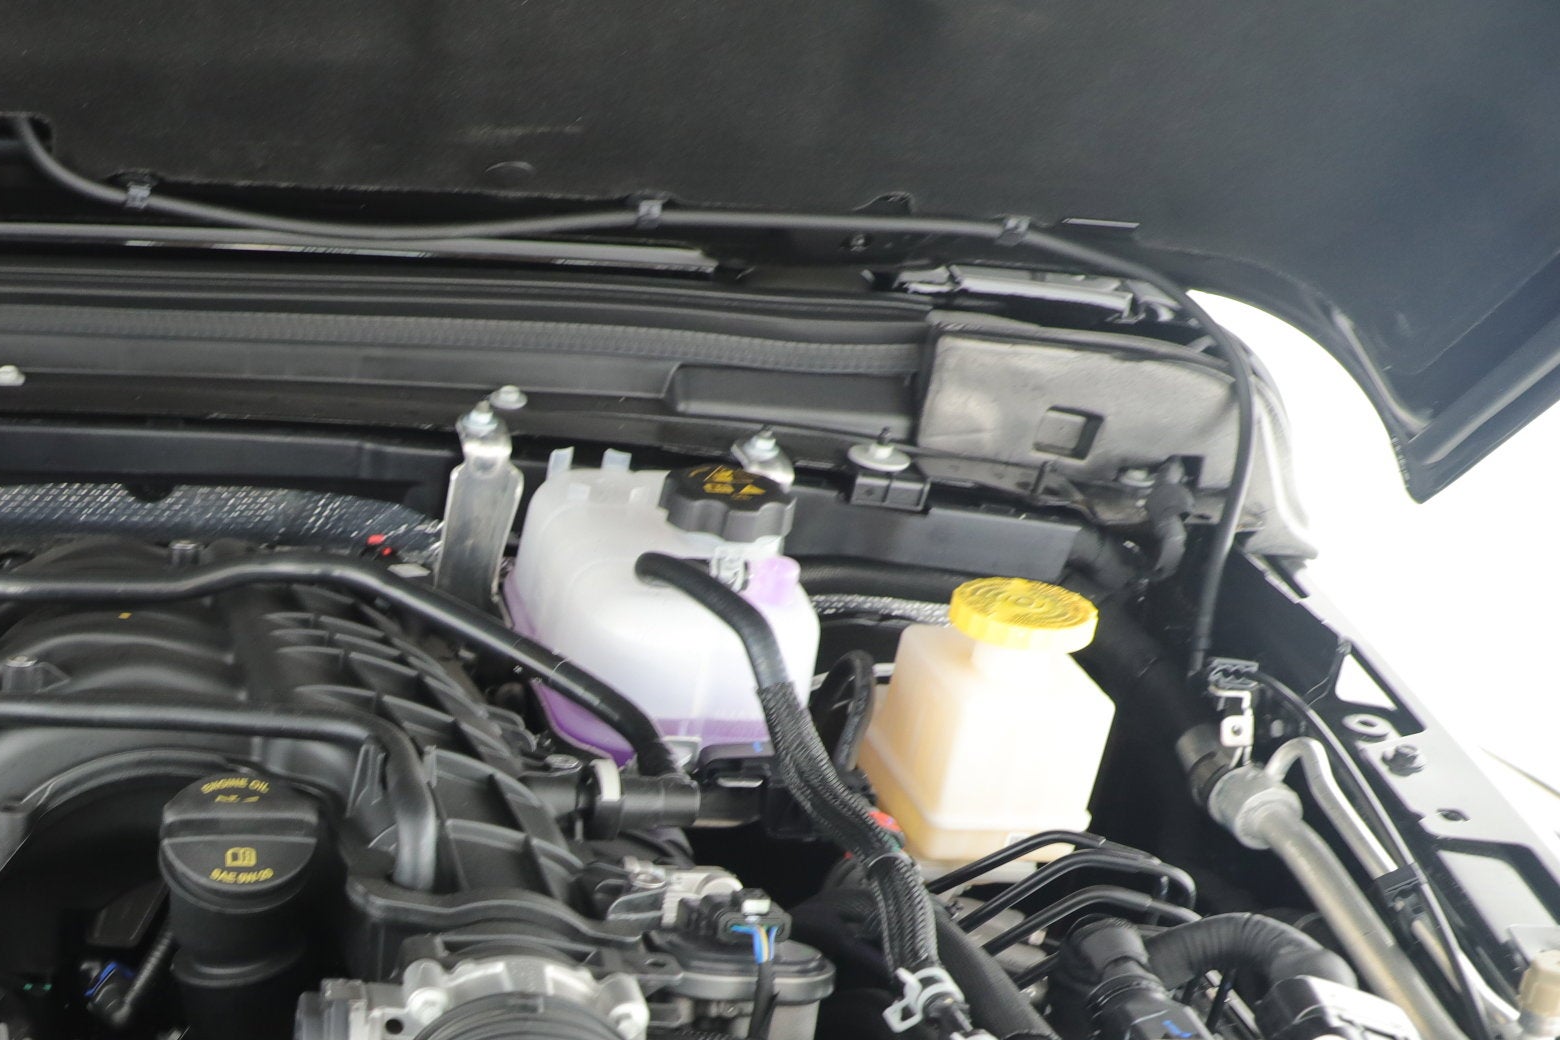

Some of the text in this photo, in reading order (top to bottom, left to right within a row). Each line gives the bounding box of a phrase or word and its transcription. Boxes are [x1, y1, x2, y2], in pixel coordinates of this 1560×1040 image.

[201, 778, 270, 794] ENGINE OIL
[210, 868, 237, 884] SAE
